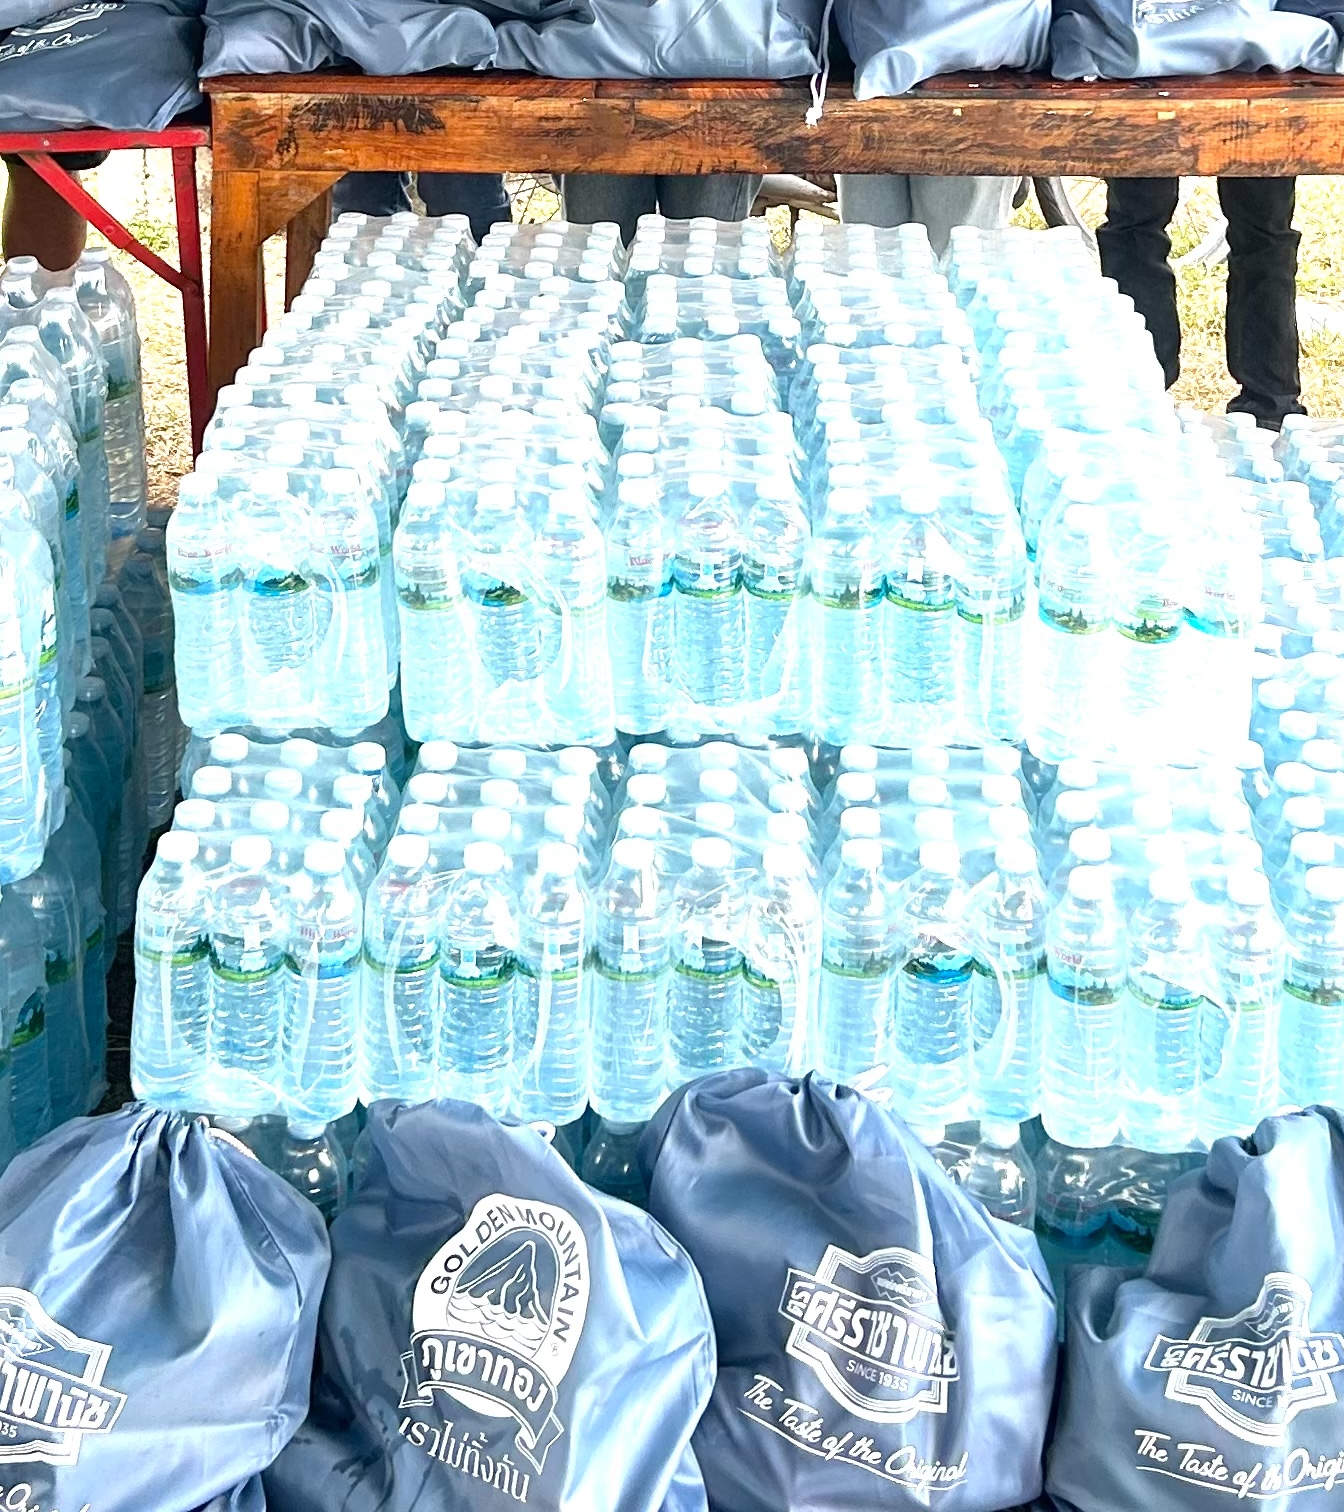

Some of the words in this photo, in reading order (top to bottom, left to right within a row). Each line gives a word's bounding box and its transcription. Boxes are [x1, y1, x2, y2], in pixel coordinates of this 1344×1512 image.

[430, 1203, 516, 1295] GOLDEN
[516, 1207, 584, 1344] MOUNTAIN
[421, 1337, 547, 1414] ภูเขาทอง
[846, 1359, 879, 1382] SINCE
[878, 1366, 910, 1393] 1935
[1231, 1389, 1274, 1410] SINCE
[398, 1415, 533, 1504] เราไม่ทิ้งกัน
[744, 1374, 784, 1411] The
[774, 1399, 822, 1444] Taste
[822, 1431, 855, 1462] of
[851, 1436, 883, 1466] the
[885, 1447, 970, 1492] Original
[1134, 1429, 1172, 1463] The
[1177, 1442, 1230, 1483] Taste
[1232, 1462, 1266, 1499] of
